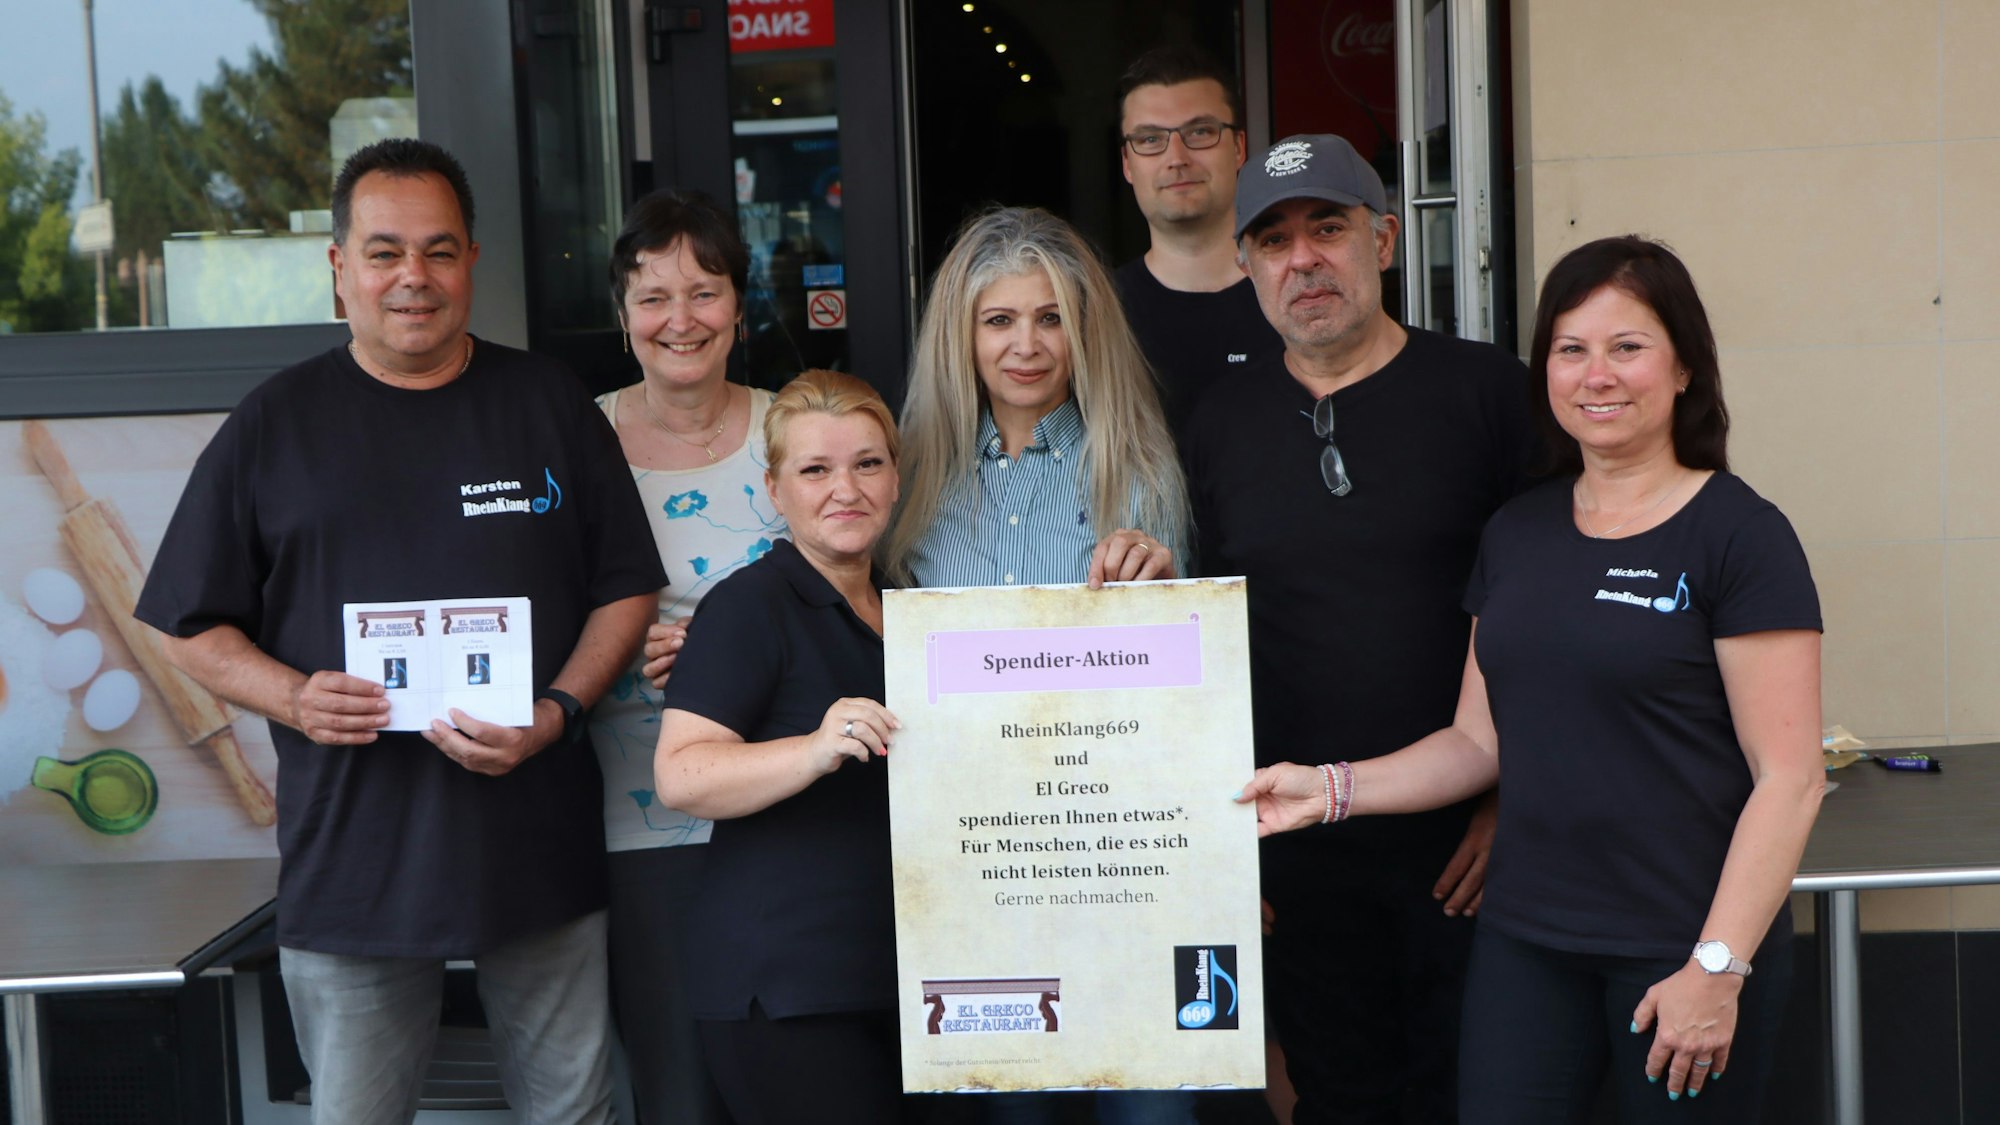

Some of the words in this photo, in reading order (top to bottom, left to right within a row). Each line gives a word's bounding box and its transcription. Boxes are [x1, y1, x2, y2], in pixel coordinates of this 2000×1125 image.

[460, 480, 522, 496] Karsten
[462, 497, 531, 517] RheinKlang
[1606, 567, 1659, 579] Michaela
[1594, 589, 1652, 608] RheinKlang
[983, 650, 1150, 675] Spendier-Aktion
[1000, 719, 1140, 740] RheinKlang669
[1054, 750, 1089, 767] und
[1036, 781, 1052, 796] El
[1057, 780, 1109, 796] Greco
[958, 810, 1060, 831] spendieren
[1065, 809, 1118, 825] Ihnen
[961, 838, 991, 854] Für
[996, 837, 1092, 854] Menschen,
[1096, 835, 1124, 851] die
[1129, 838, 1148, 850] es
[1152, 833, 1189, 849] sich
[981, 864, 1027, 880] nicht
[1031, 863, 1092, 879] leisten
[1096, 861, 1170, 878] können.
[994, 891, 1044, 906] Gerne
[1048, 889, 1159, 905] nachmachen.
[1195, 949, 1209, 1000] RheinKlang
[957, 1005, 978, 1017] EL
[981, 1003, 1034, 1016] GRECO
[1182, 1006, 1211, 1023] 669
[943, 1018, 1042, 1032] RESTAURANT
